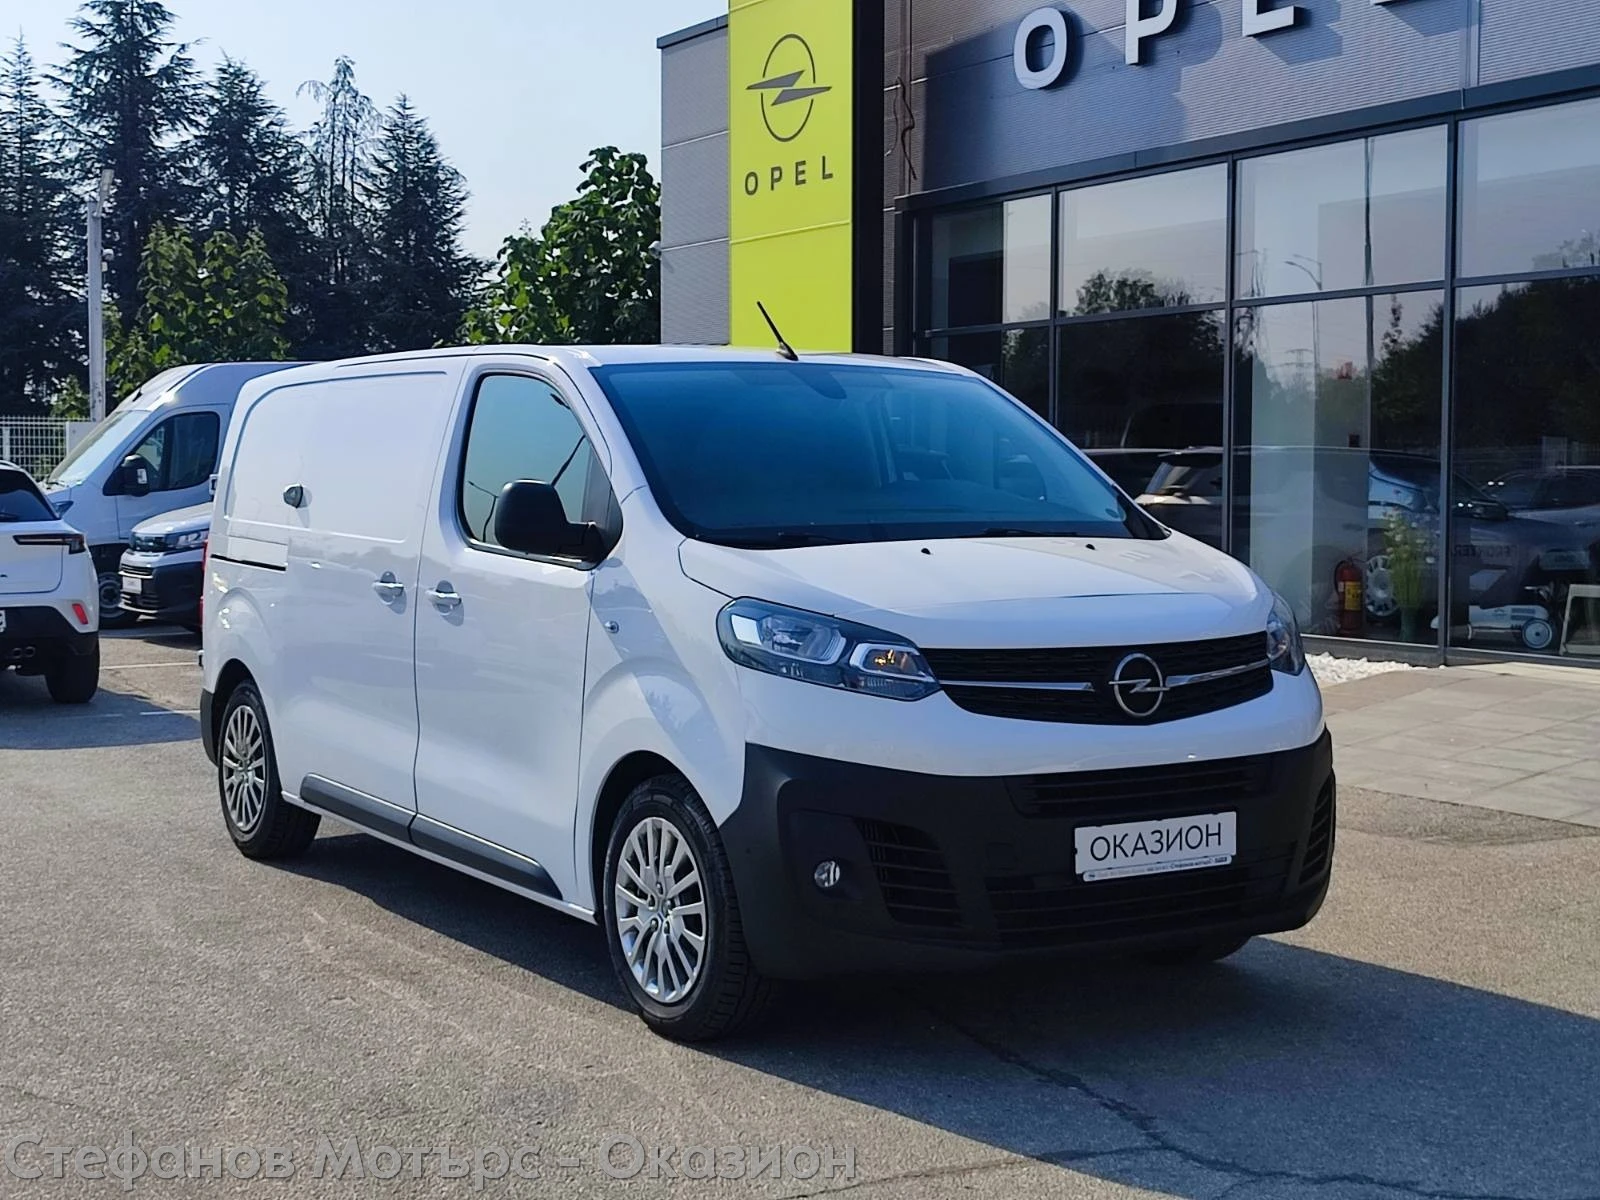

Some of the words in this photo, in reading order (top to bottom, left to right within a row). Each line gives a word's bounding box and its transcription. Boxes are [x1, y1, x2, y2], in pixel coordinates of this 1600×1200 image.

[1013, 0, 1392, 90] OP
[744, 155, 834, 196] OPEL
[1089, 822, 1222, 861] ОКАЗИОН
